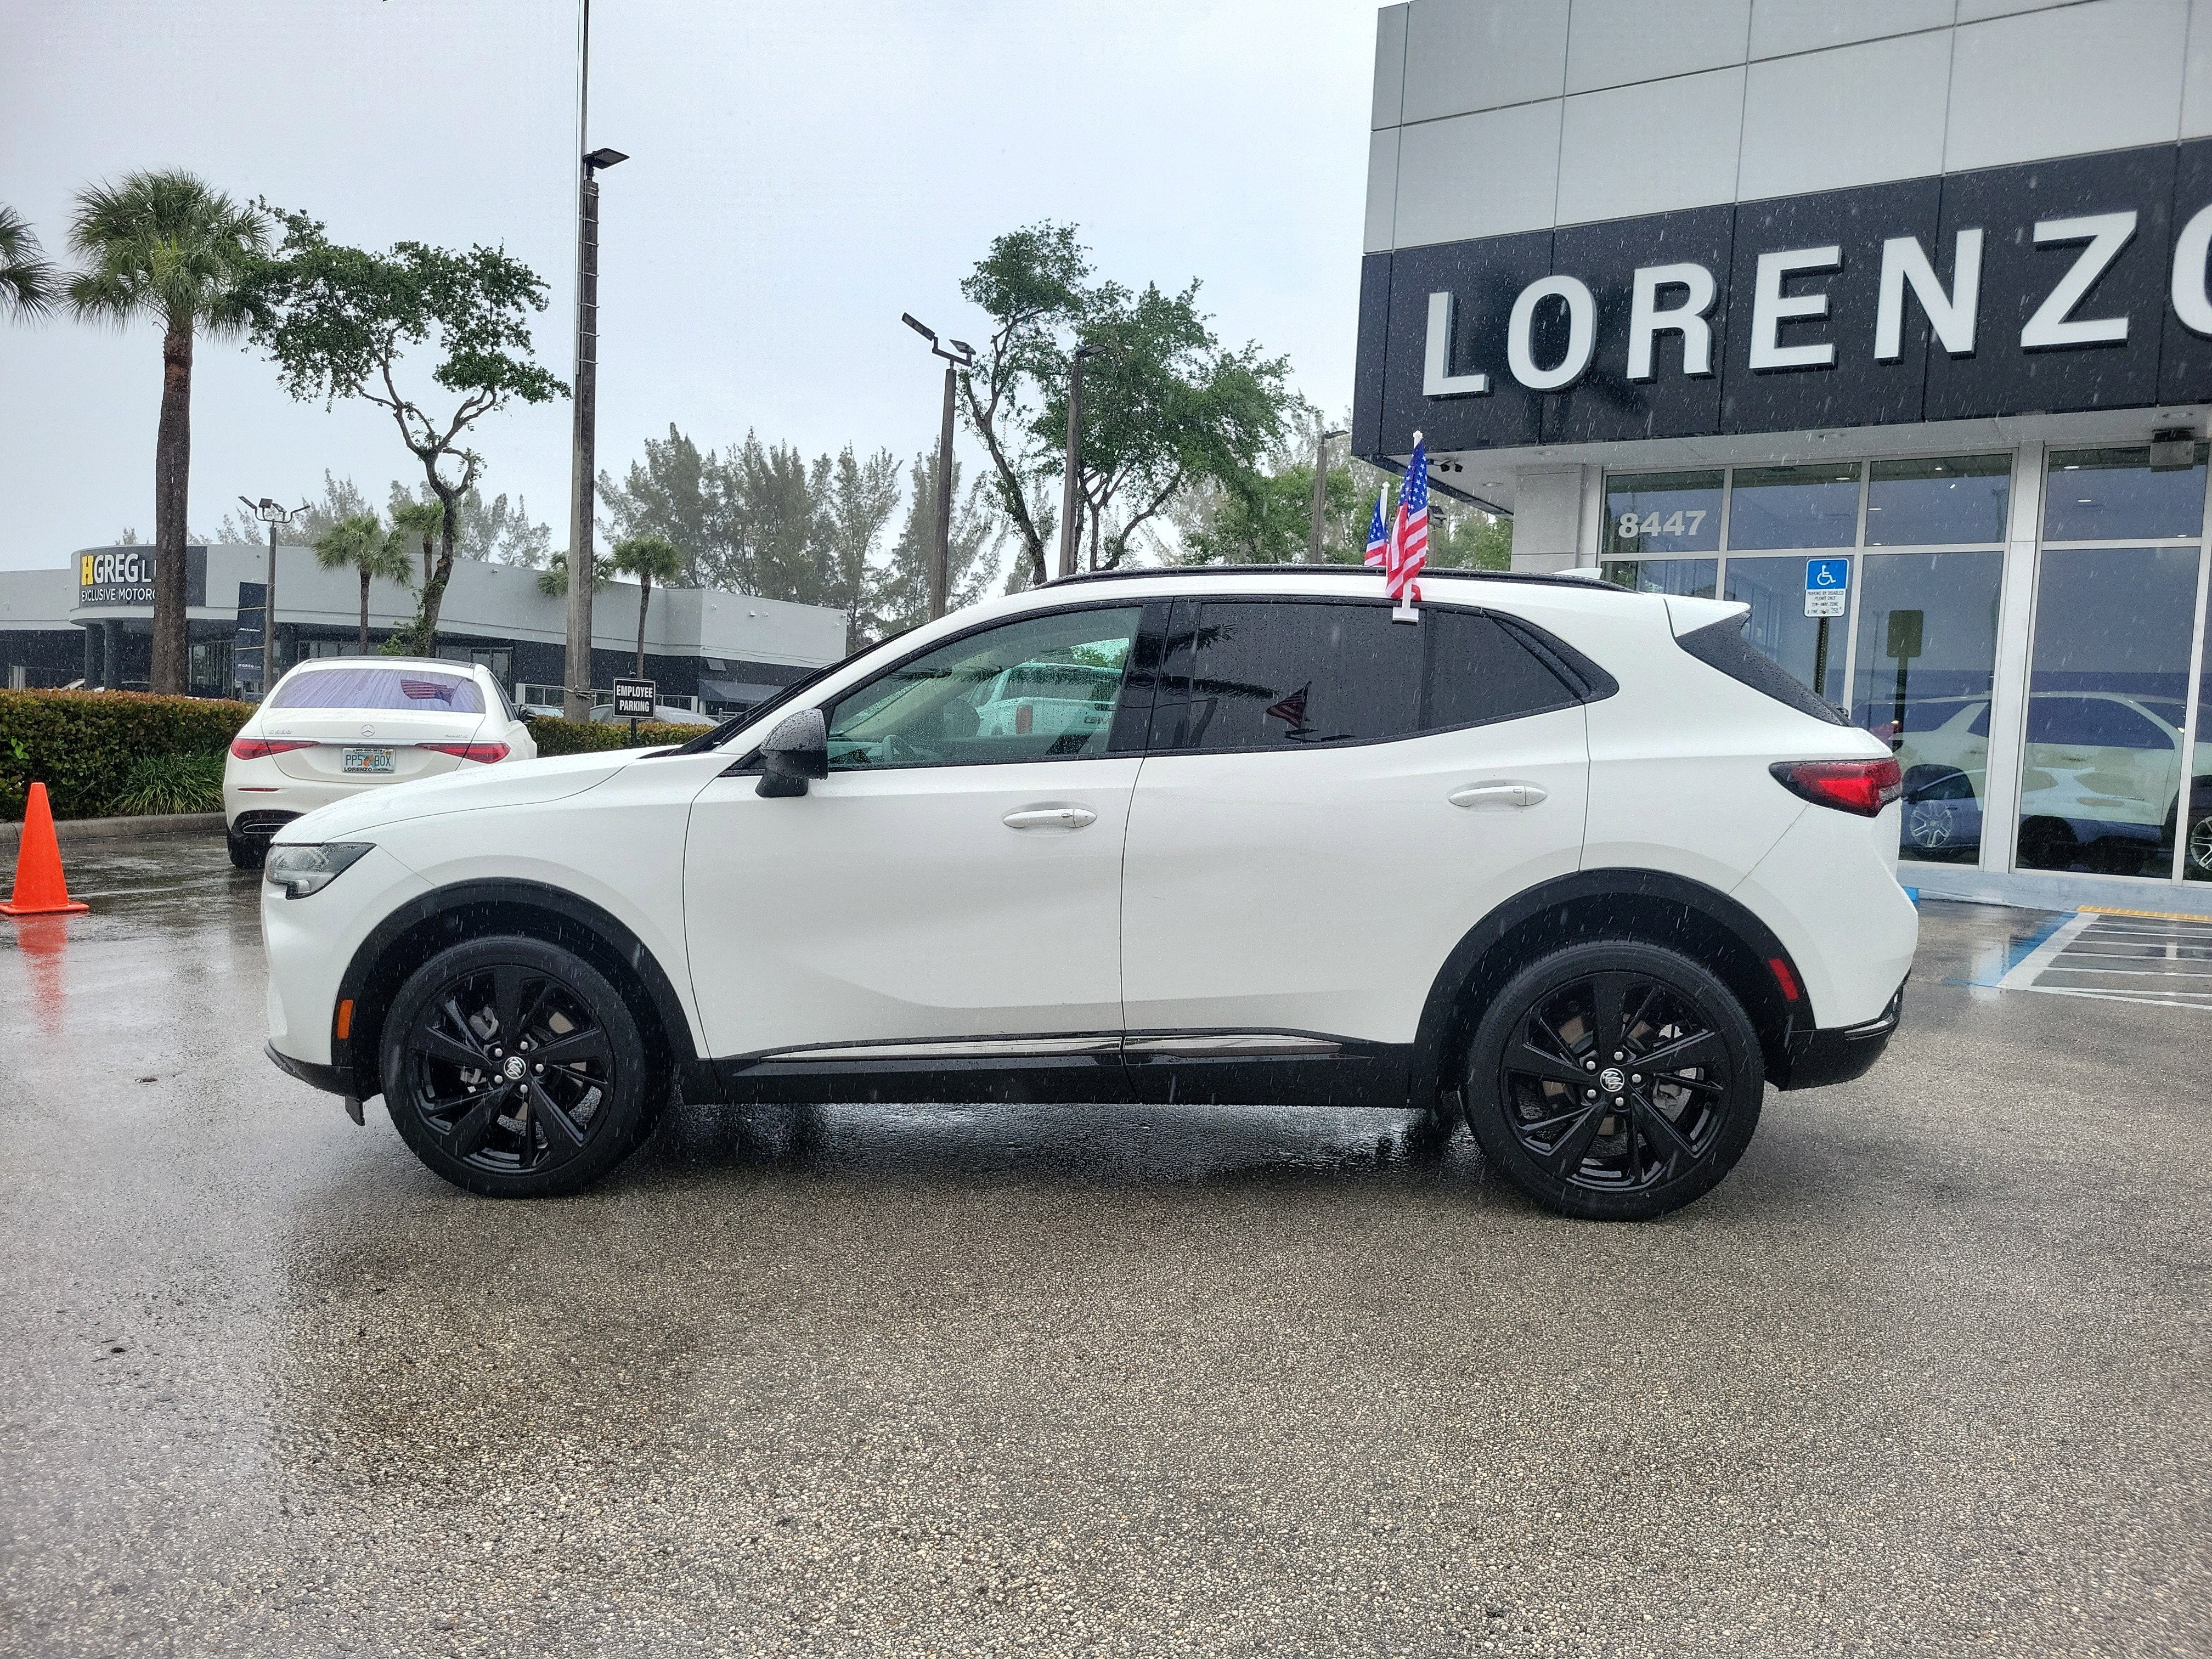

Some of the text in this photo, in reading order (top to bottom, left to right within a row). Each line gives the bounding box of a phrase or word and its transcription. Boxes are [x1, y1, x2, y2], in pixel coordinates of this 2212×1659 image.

[1618, 510, 1706, 538] 8447
[81, 553, 157, 585] HGREG L
[82, 588, 116, 602] EXCLUSIVE
[617, 685, 653, 698] EMPLOYEE
[619, 699, 650, 712] PARKING
